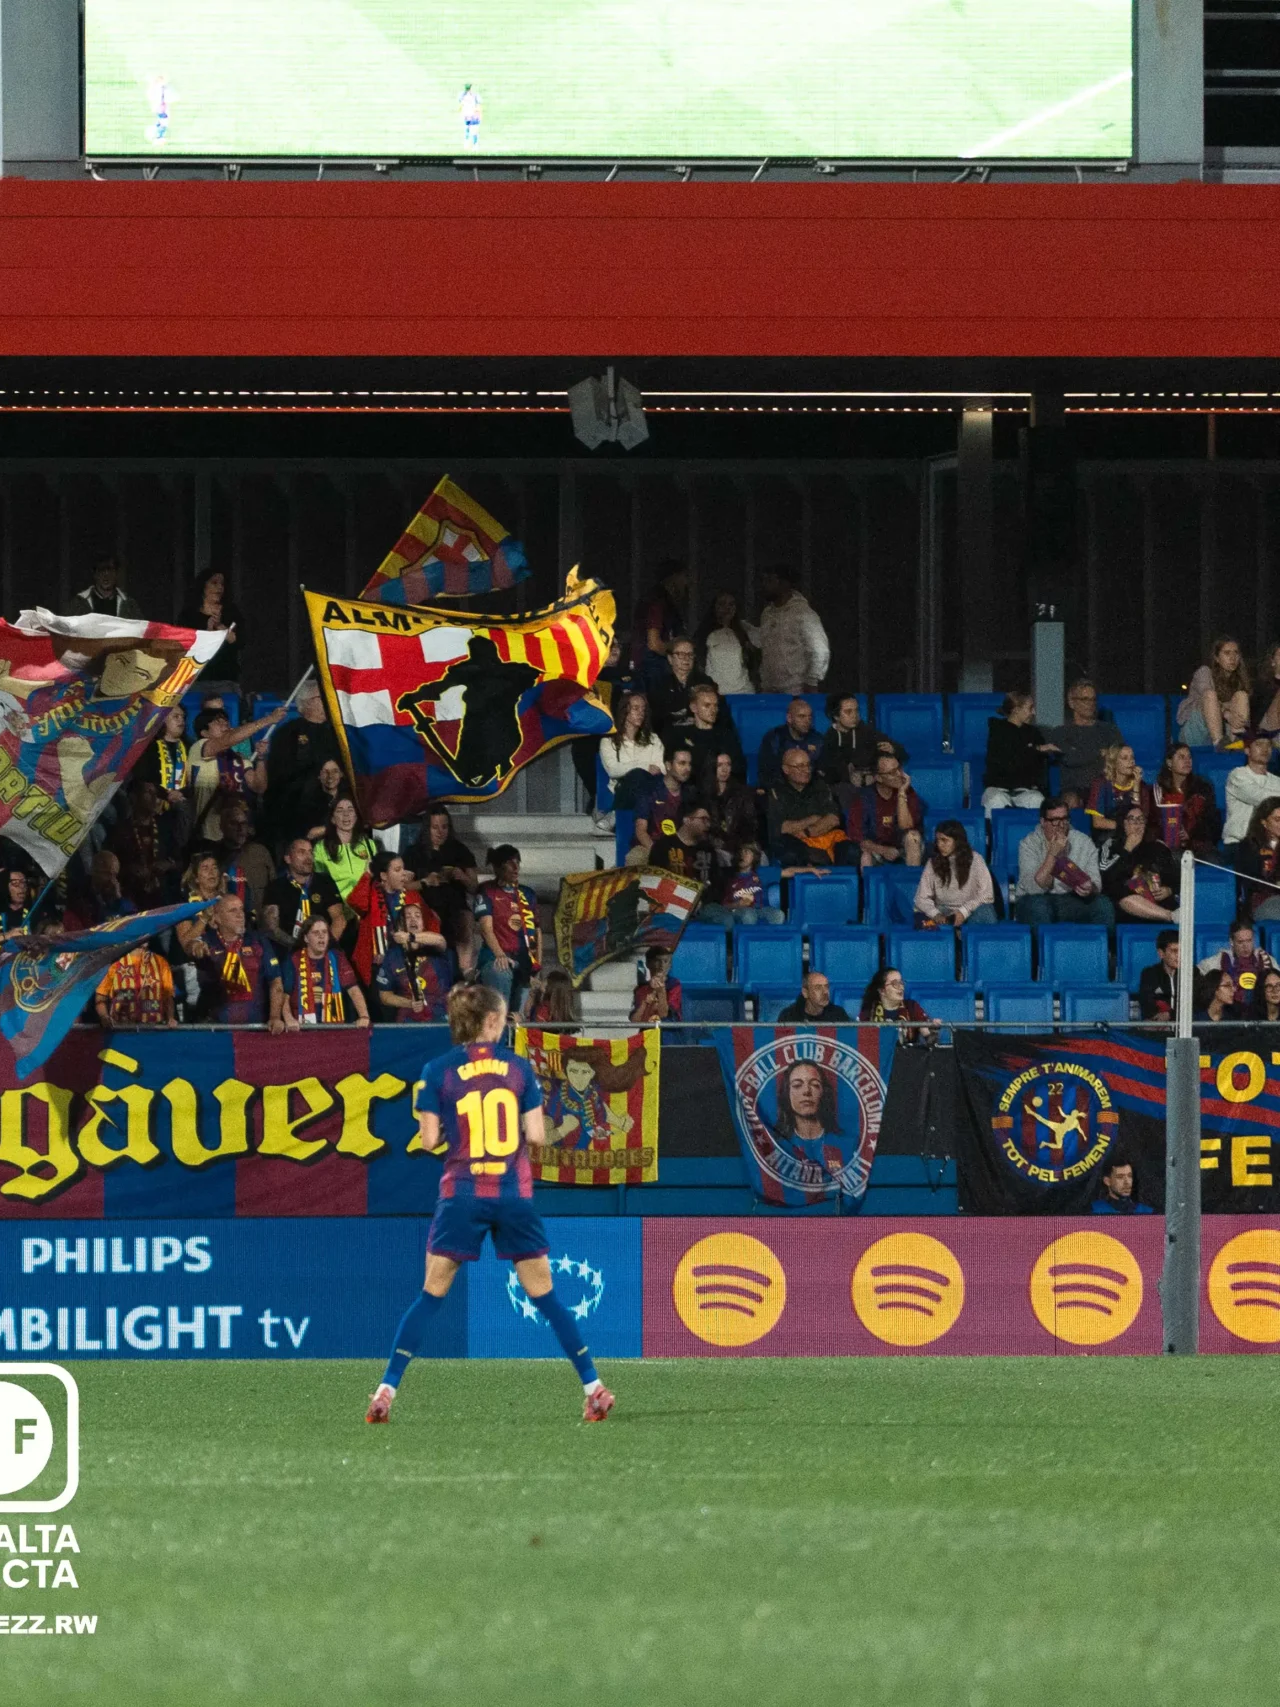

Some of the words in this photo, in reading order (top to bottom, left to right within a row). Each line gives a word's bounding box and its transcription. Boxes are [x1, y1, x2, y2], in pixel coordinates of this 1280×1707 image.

[783, 1042, 826, 1064] CLUB
[829, 1050, 884, 1133] BARCELONA
[999, 1065, 1040, 1112] SEMPRE
[1042, 1062, 1112, 1109] T'ANIMAREM
[1048, 1083, 1064, 1096] 22
[456, 1088, 519, 1158] 10
[765, 1148, 823, 1183] AITANA
[1001, 1138, 1029, 1169] TOT
[1027, 1166, 1060, 1182] PEL
[1063, 1132, 1111, 1181] FEMENÍ
[22, 1236, 213, 1273] PHILIPS
[258, 1308, 310, 1349] tv
